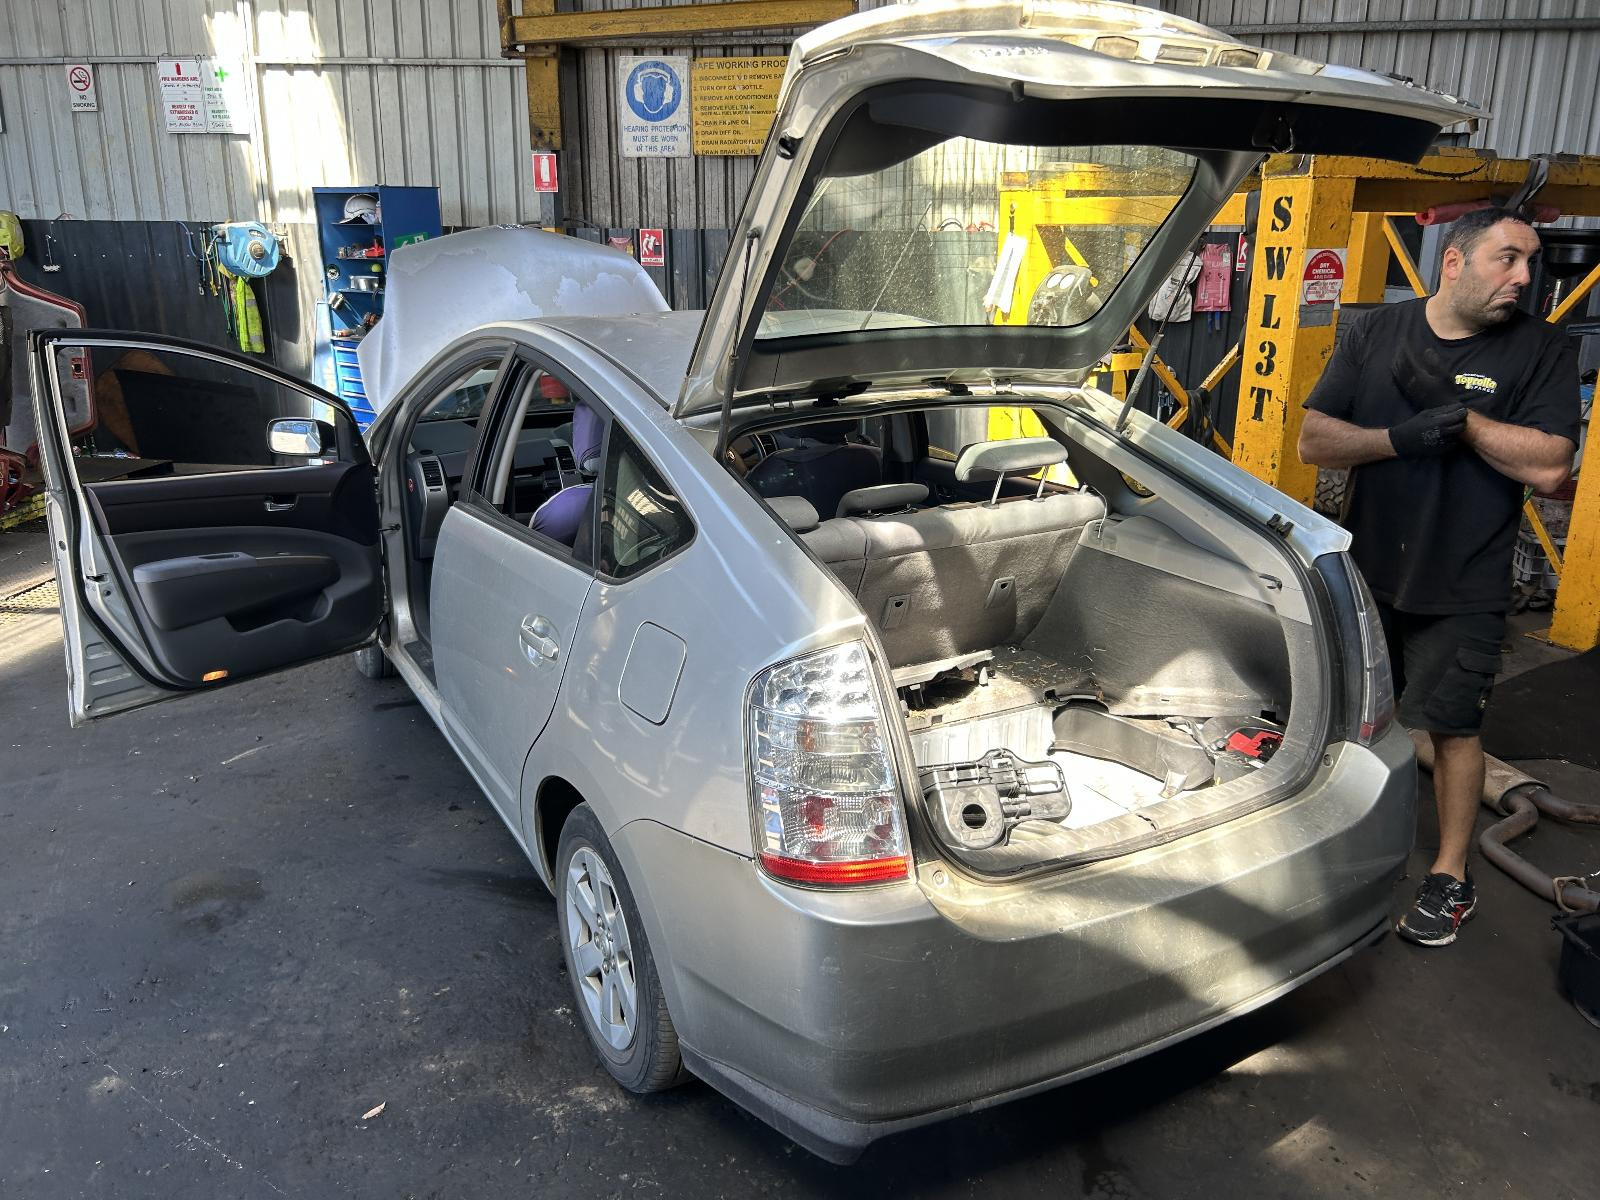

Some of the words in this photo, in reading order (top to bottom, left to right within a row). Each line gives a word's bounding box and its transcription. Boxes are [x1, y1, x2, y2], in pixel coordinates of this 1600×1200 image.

[716, 61, 759, 70] WORKING
[761, 60, 788, 69] PROC
[624, 125, 649, 133] HEARING
[651, 124, 687, 133] PROTECTION
